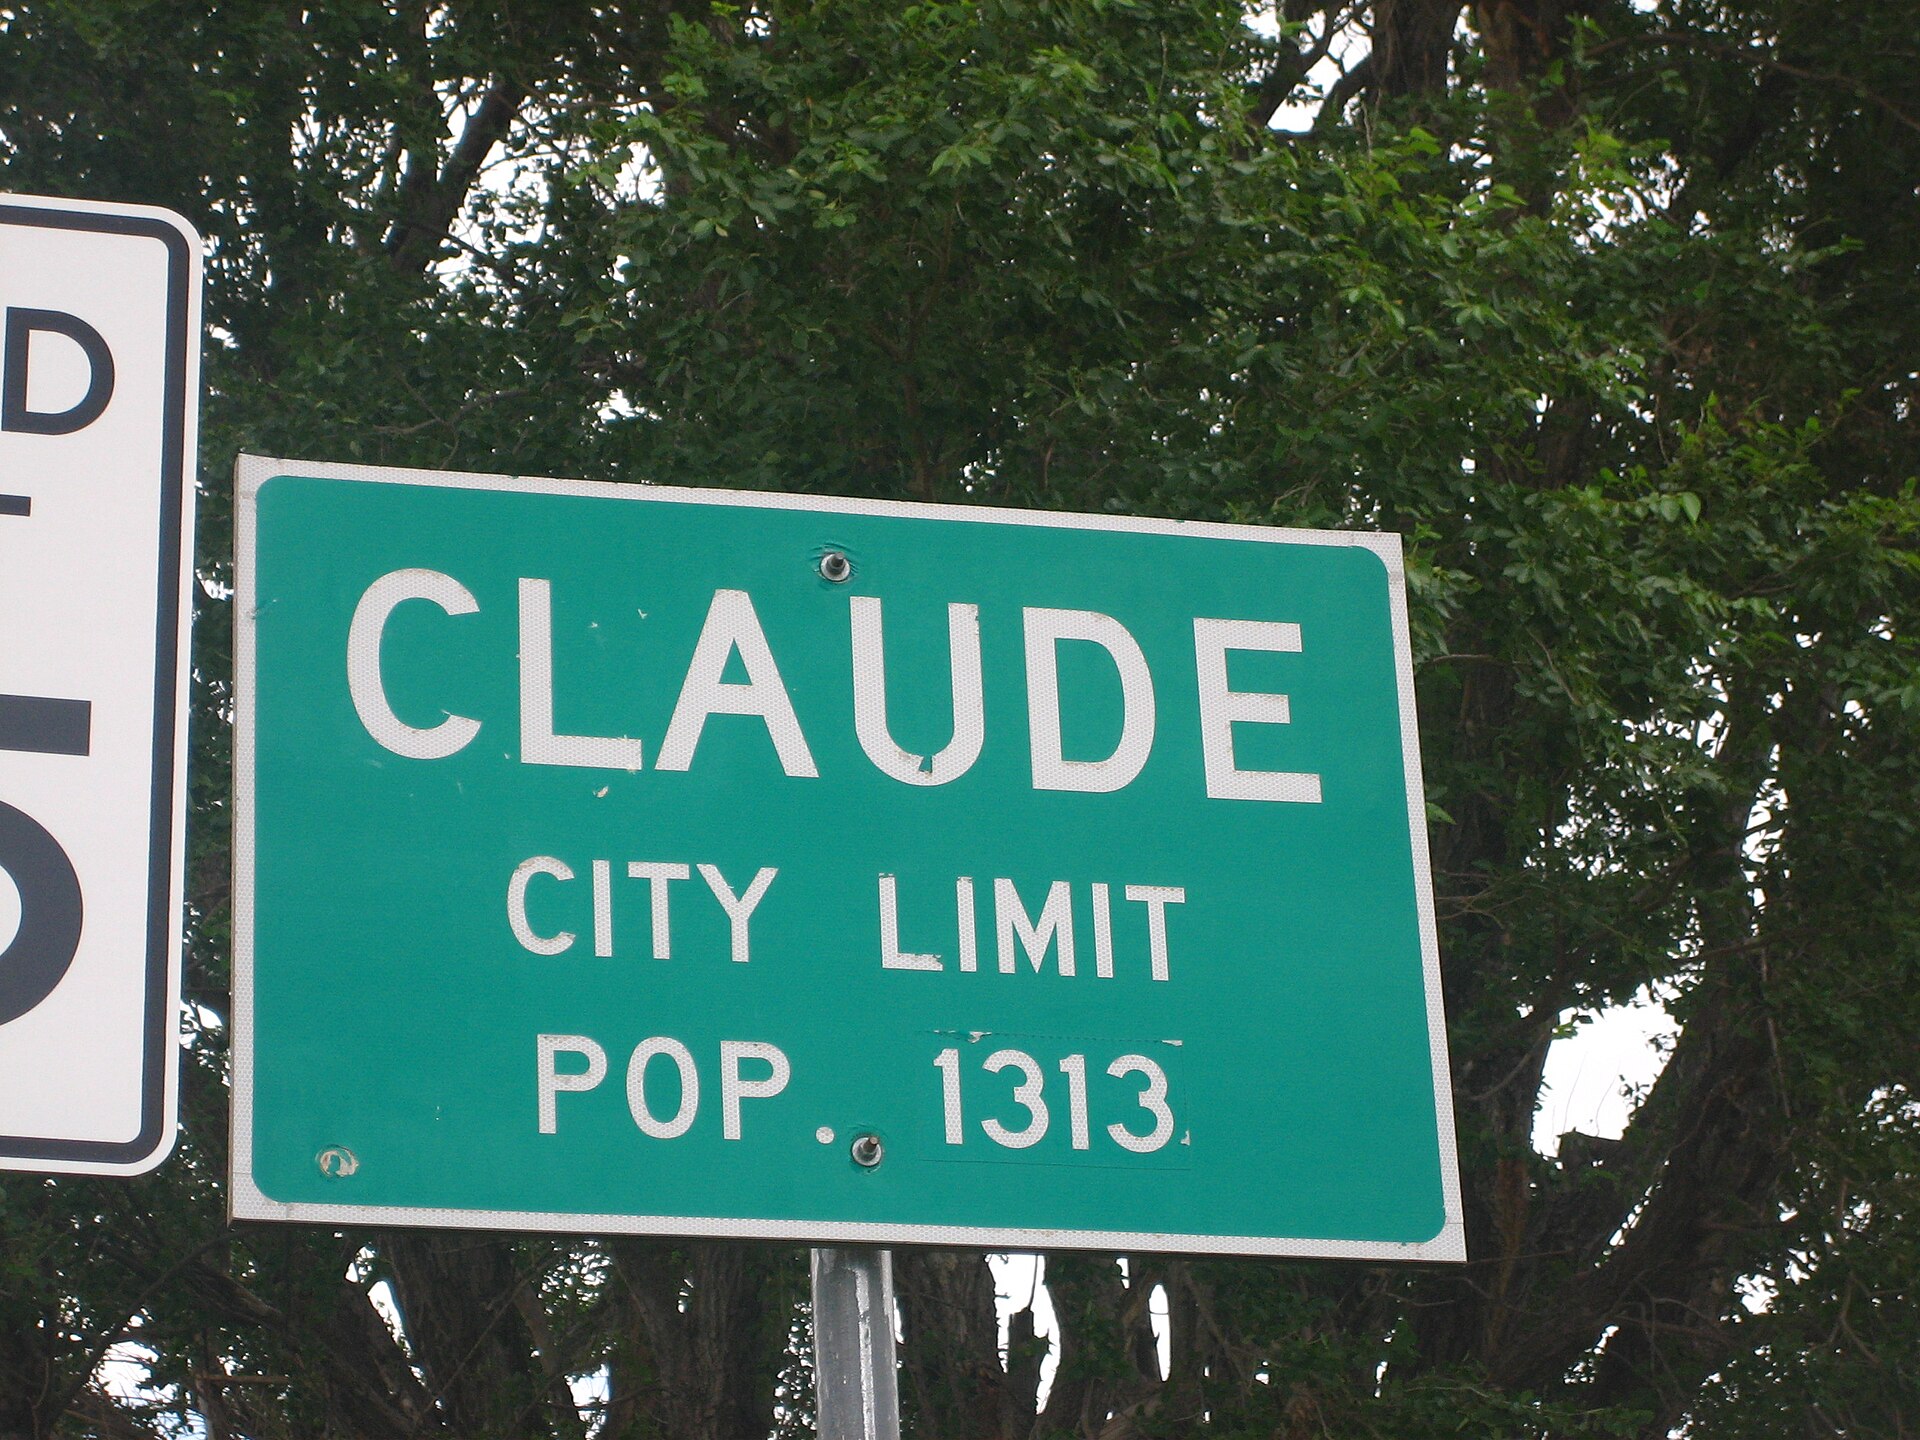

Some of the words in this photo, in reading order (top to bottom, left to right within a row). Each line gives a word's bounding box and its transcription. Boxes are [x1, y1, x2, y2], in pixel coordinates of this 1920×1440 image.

[347, 568, 1322, 804] CLAUDE
[507, 856, 778, 963] CITY
[879, 873, 1185, 982] LIMIT
[537, 1034, 834, 1144] POP.
[933, 1048, 1175, 1153] 1313
